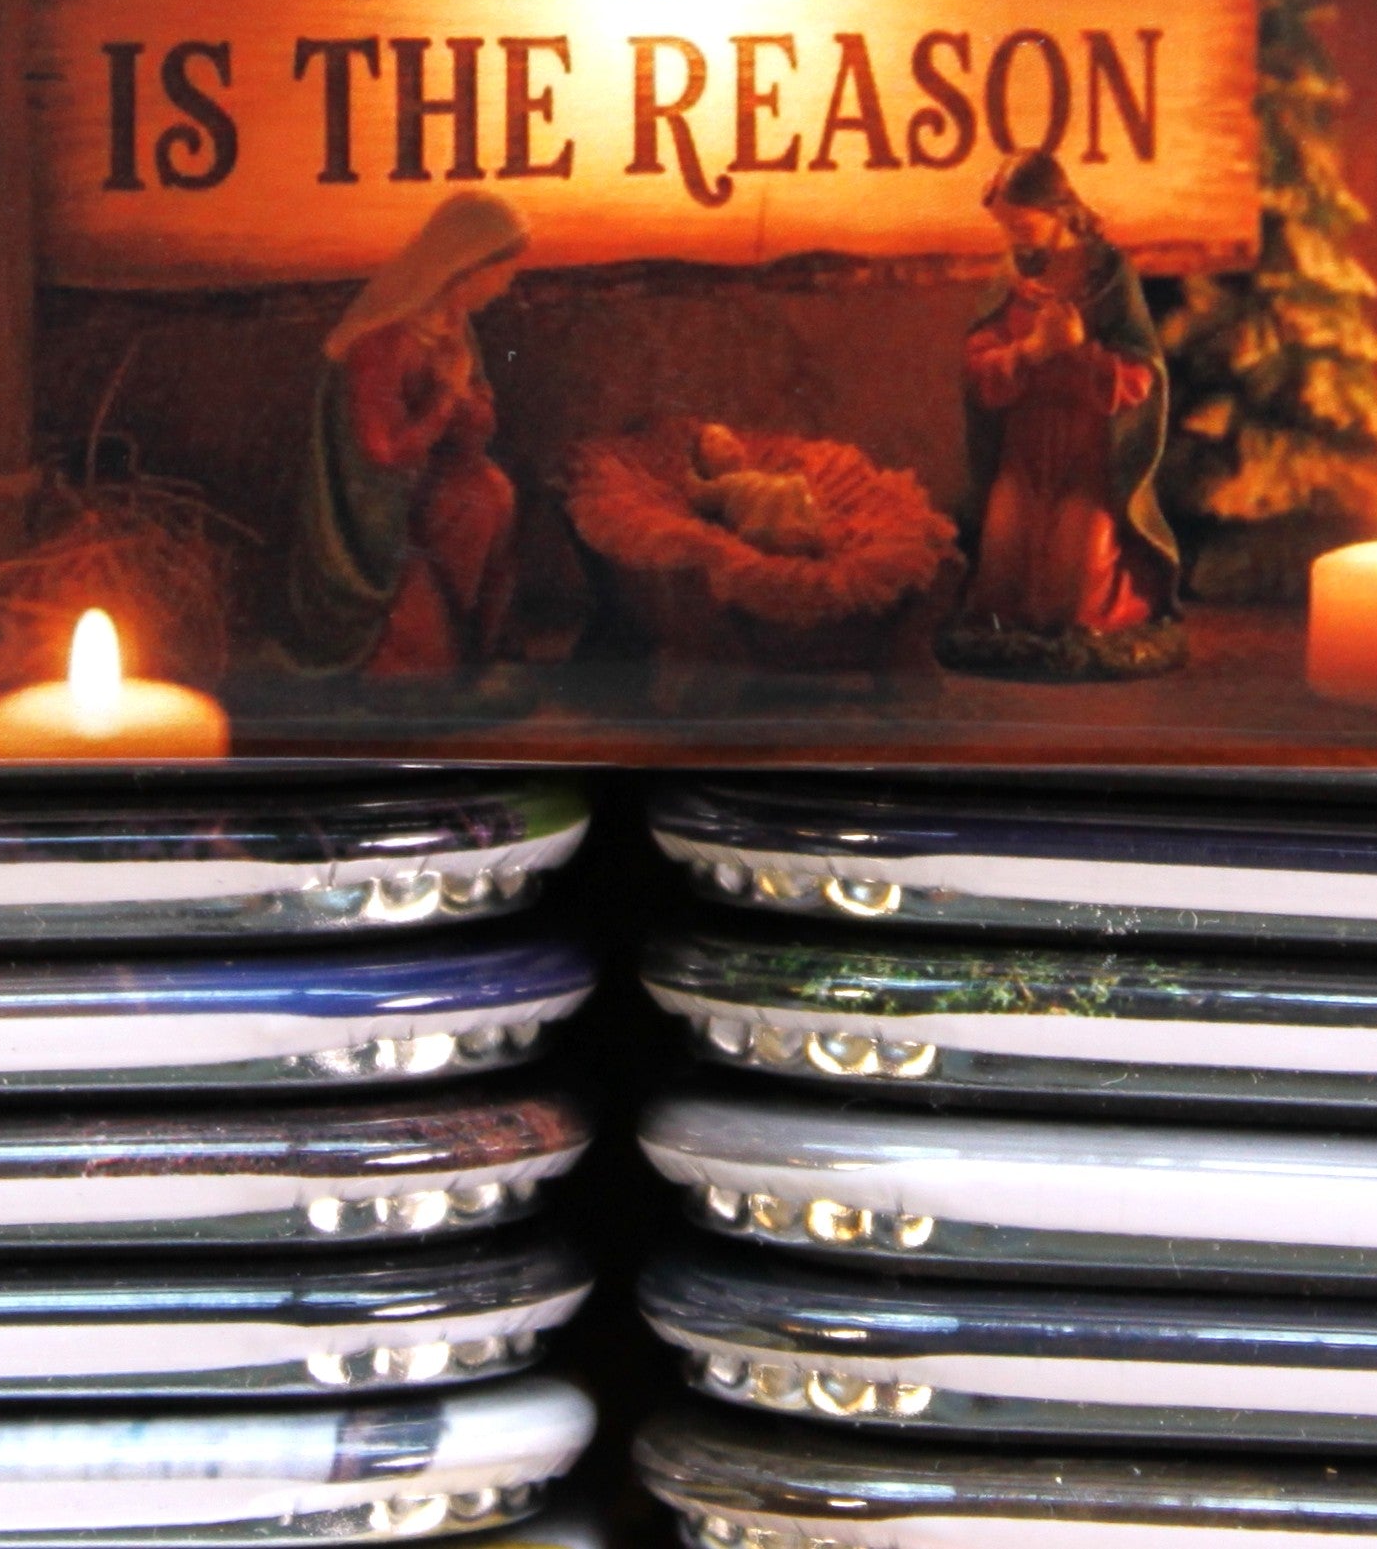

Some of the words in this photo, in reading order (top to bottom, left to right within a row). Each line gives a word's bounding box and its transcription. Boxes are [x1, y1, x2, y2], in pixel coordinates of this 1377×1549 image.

[101, 40, 240, 192] IS
[293, 35, 574, 186] THE
[625, 28, 1163, 209] REASON
